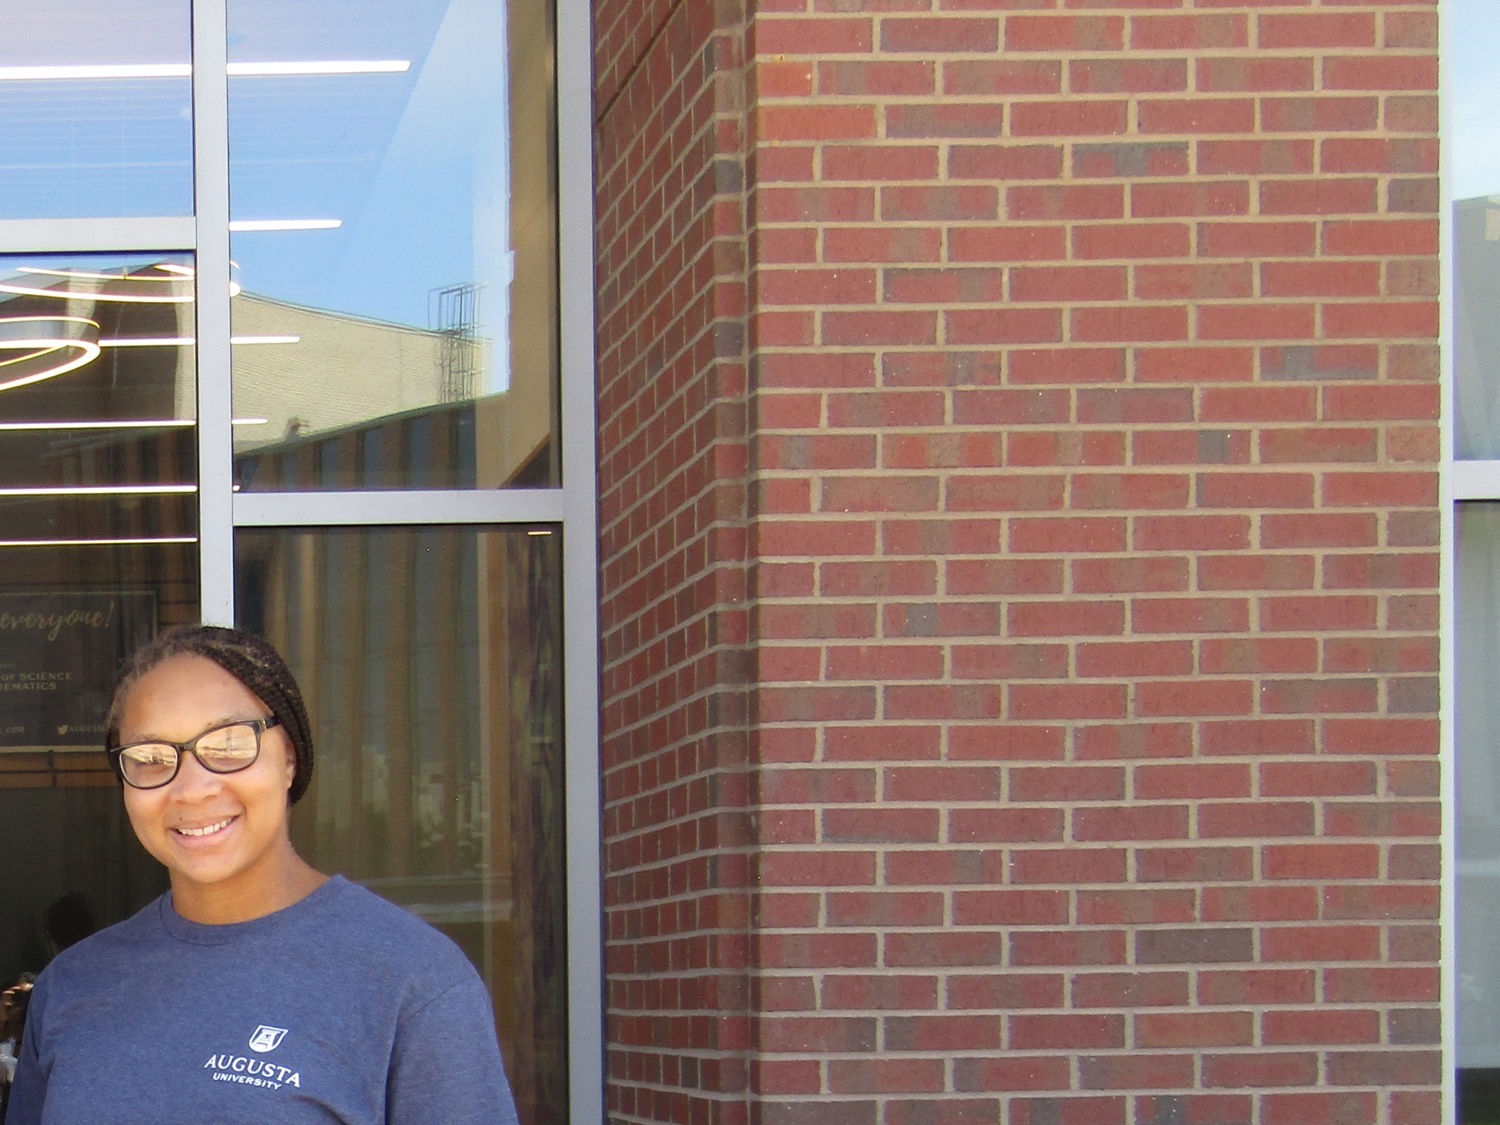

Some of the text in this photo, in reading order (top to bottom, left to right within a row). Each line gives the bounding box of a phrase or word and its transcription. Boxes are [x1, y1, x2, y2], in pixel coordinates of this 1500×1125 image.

[0, 601, 115, 642] everyone!
[19, 672, 73, 681] SCIENCE
[204, 1054, 301, 1088] AUGUSTA
[212, 1072, 282, 1090] UNIVERSITY
